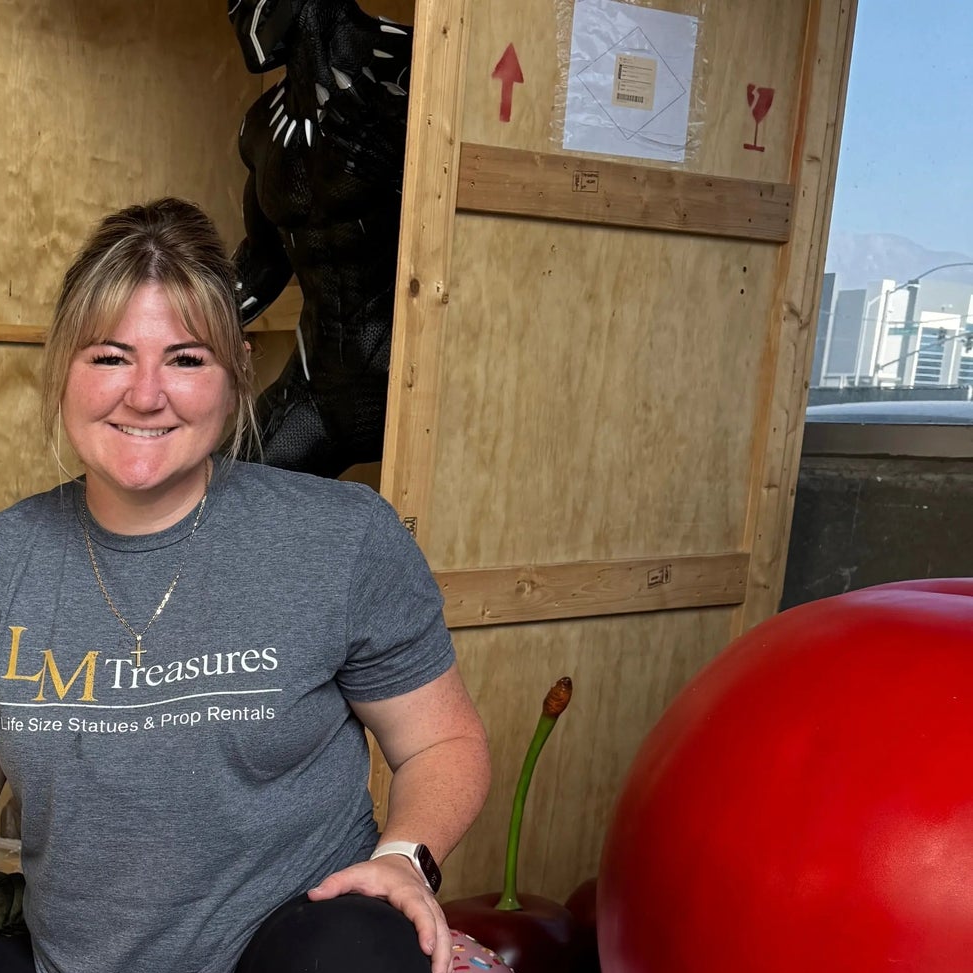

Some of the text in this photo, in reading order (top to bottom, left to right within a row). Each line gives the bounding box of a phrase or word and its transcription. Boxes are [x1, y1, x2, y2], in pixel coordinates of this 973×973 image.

[0, 625, 279, 702] LM Treasures
[0, 705, 275, 733] Life Size Statues & Prop Rentals
